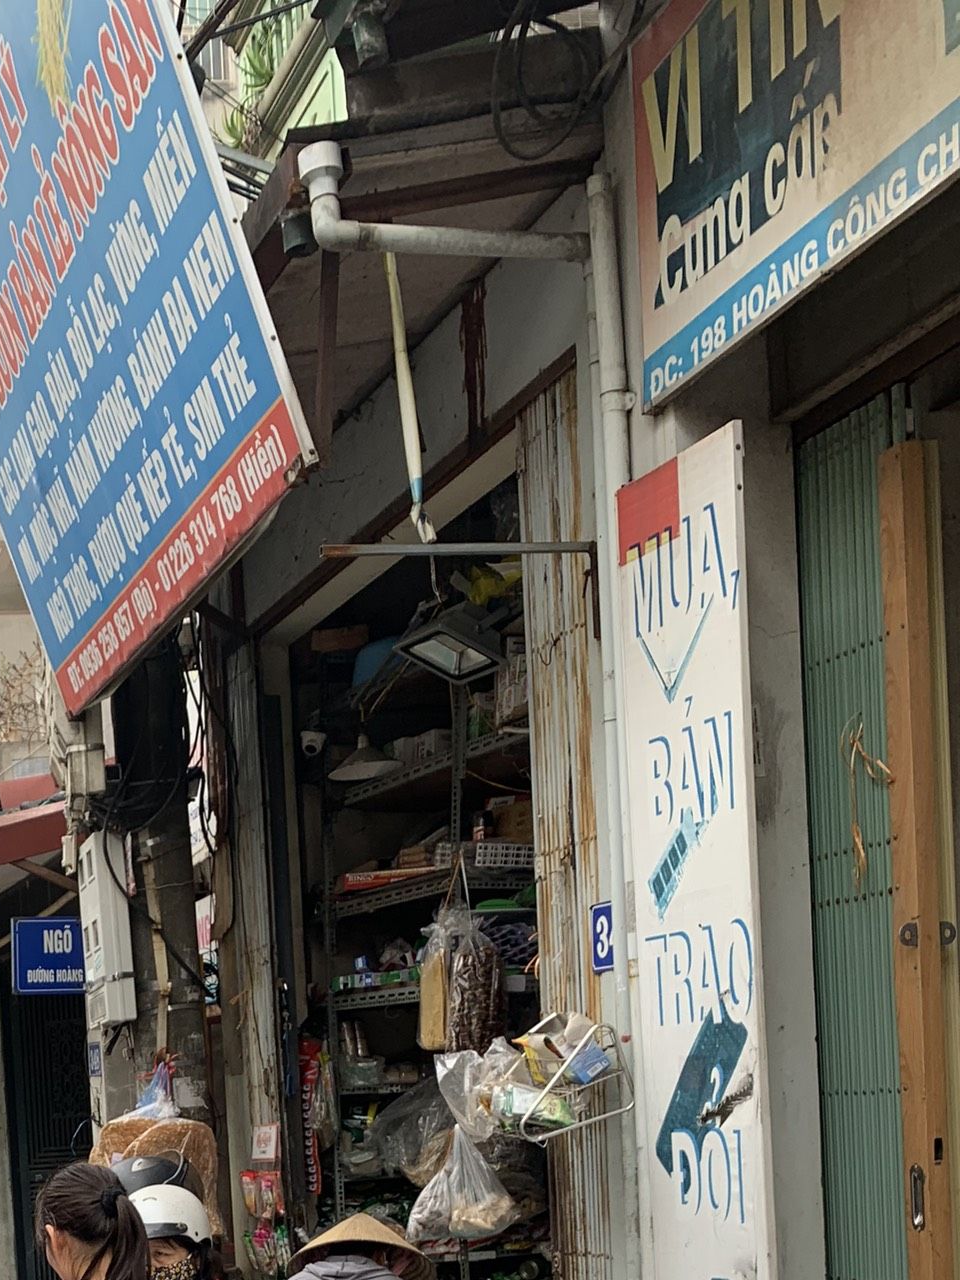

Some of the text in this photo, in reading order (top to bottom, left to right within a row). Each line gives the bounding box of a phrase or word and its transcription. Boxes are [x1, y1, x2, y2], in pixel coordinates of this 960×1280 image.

[33, 146, 74, 278] LẺ
[53, 64, 121, 237] NÔNG
[8, 424, 37, 488] LOẠI
[25, 388, 59, 457] GẠO,
[44, 347, 81, 422] ĐẬU,
[67, 299, 93, 381] ĐỖ
[81, 271, 121, 353] LẠC,
[105, 200, 159, 304] VỪNG,
[143, 110, 196, 233] MIẾN
[9, 218, 56, 340] BÁN
[650, 355, 683, 400] ĐC:
[690, 315, 727, 367] 198
[732, 238, 819, 333] HOÀNG
[827, 166, 907, 258] CÔNG
[660, 172, 750, 304] Cung
[30, 499, 57, 564] MỘC
[66, 432, 99, 509] NẤM
[87, 373, 142, 470] HƯƠNG,
[127, 311, 173, 408] BÁNH
[161, 277, 197, 353] ĐA
[183, 211, 234, 318] NEM
[46, 317, 256, 642] NGÔ THÓC, RƯỢU QUÊ NẾP TẺ, SIM THẺ
[66, 660, 84, 692] ĐT:
[78, 638, 103, 679] 0936
[96, 619, 119, 659] 258
[112, 599, 135, 641] 857
[130, 576, 157, 624] (Độ)
[156, 532, 194, 592] 01226
[188, 506, 216, 555] 314
[211, 475, 241, 528] 768
[237, 424, 287, 500] (Hiền)
[43, 925, 72, 954] NGÕ
[56, 965, 84, 982] HOÀNG
[645, 918, 754, 1027] TRAO
